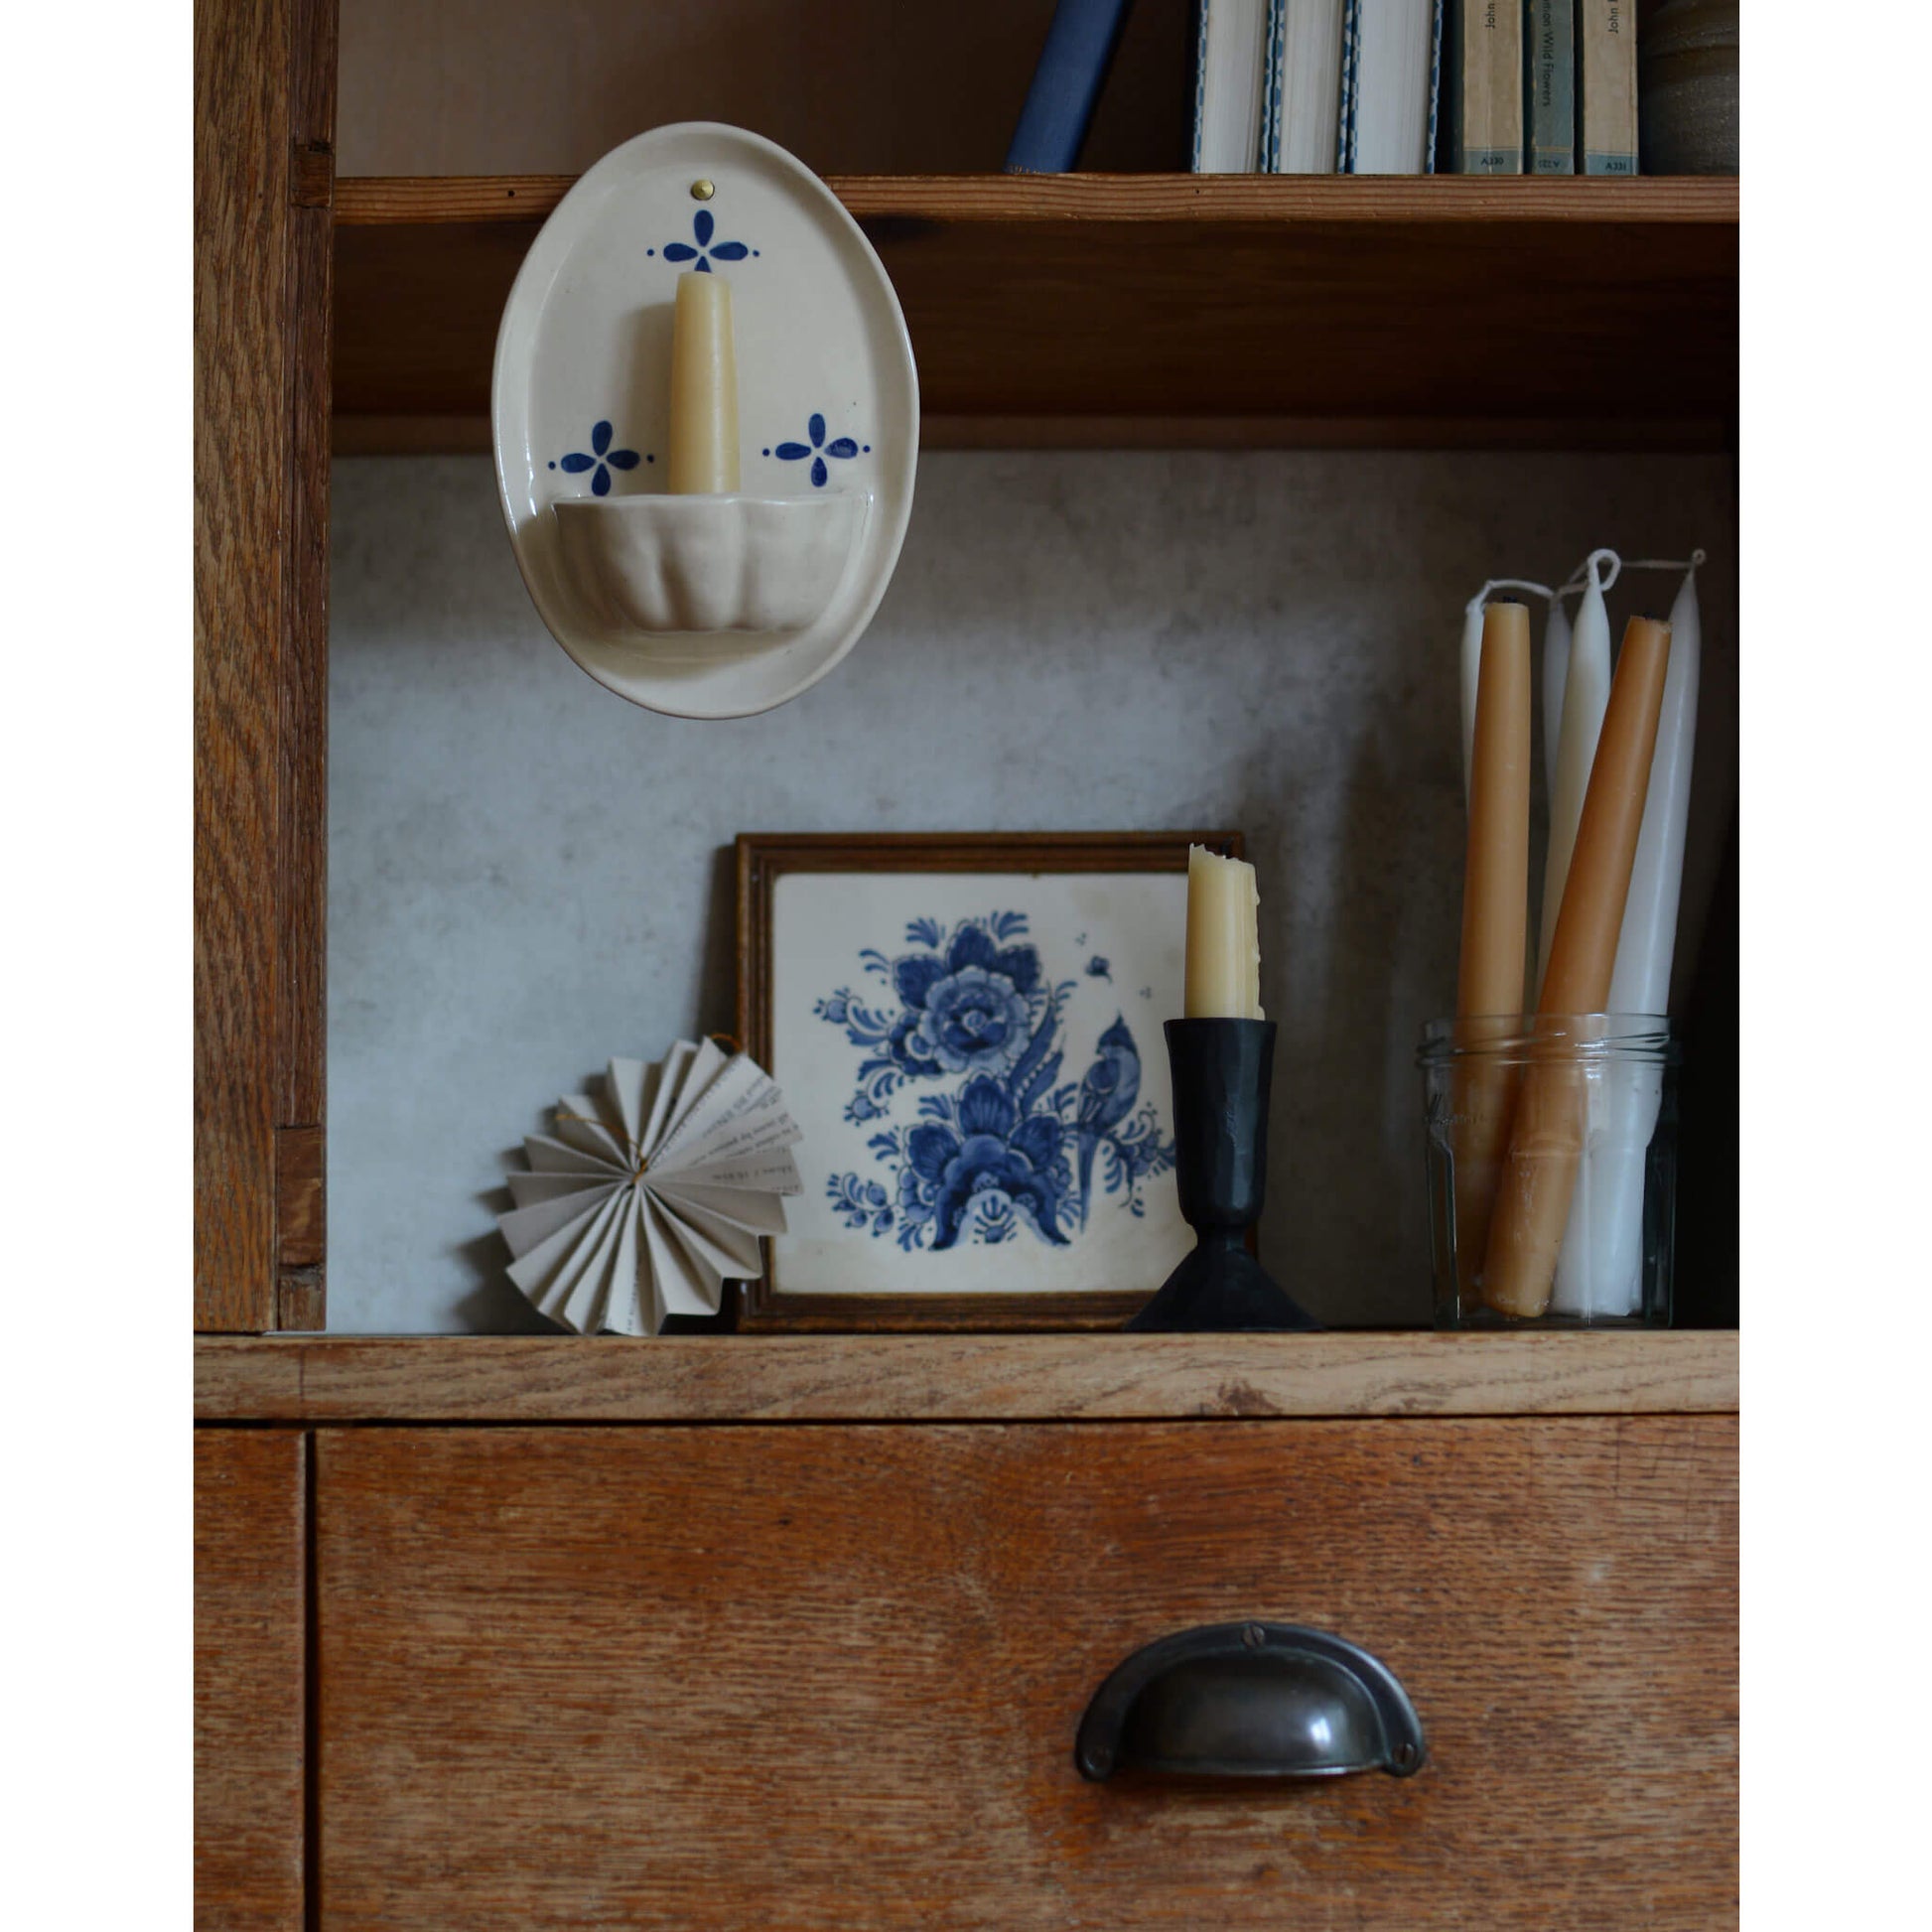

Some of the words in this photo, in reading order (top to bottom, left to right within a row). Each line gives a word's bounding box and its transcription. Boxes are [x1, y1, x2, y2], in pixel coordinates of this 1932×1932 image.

[1485, 3, 1495, 29] John
[1608, 7, 1618, 34] John
[1543, 32, 1554, 60] Wild
[1543, 64, 1554, 107] Flowers
